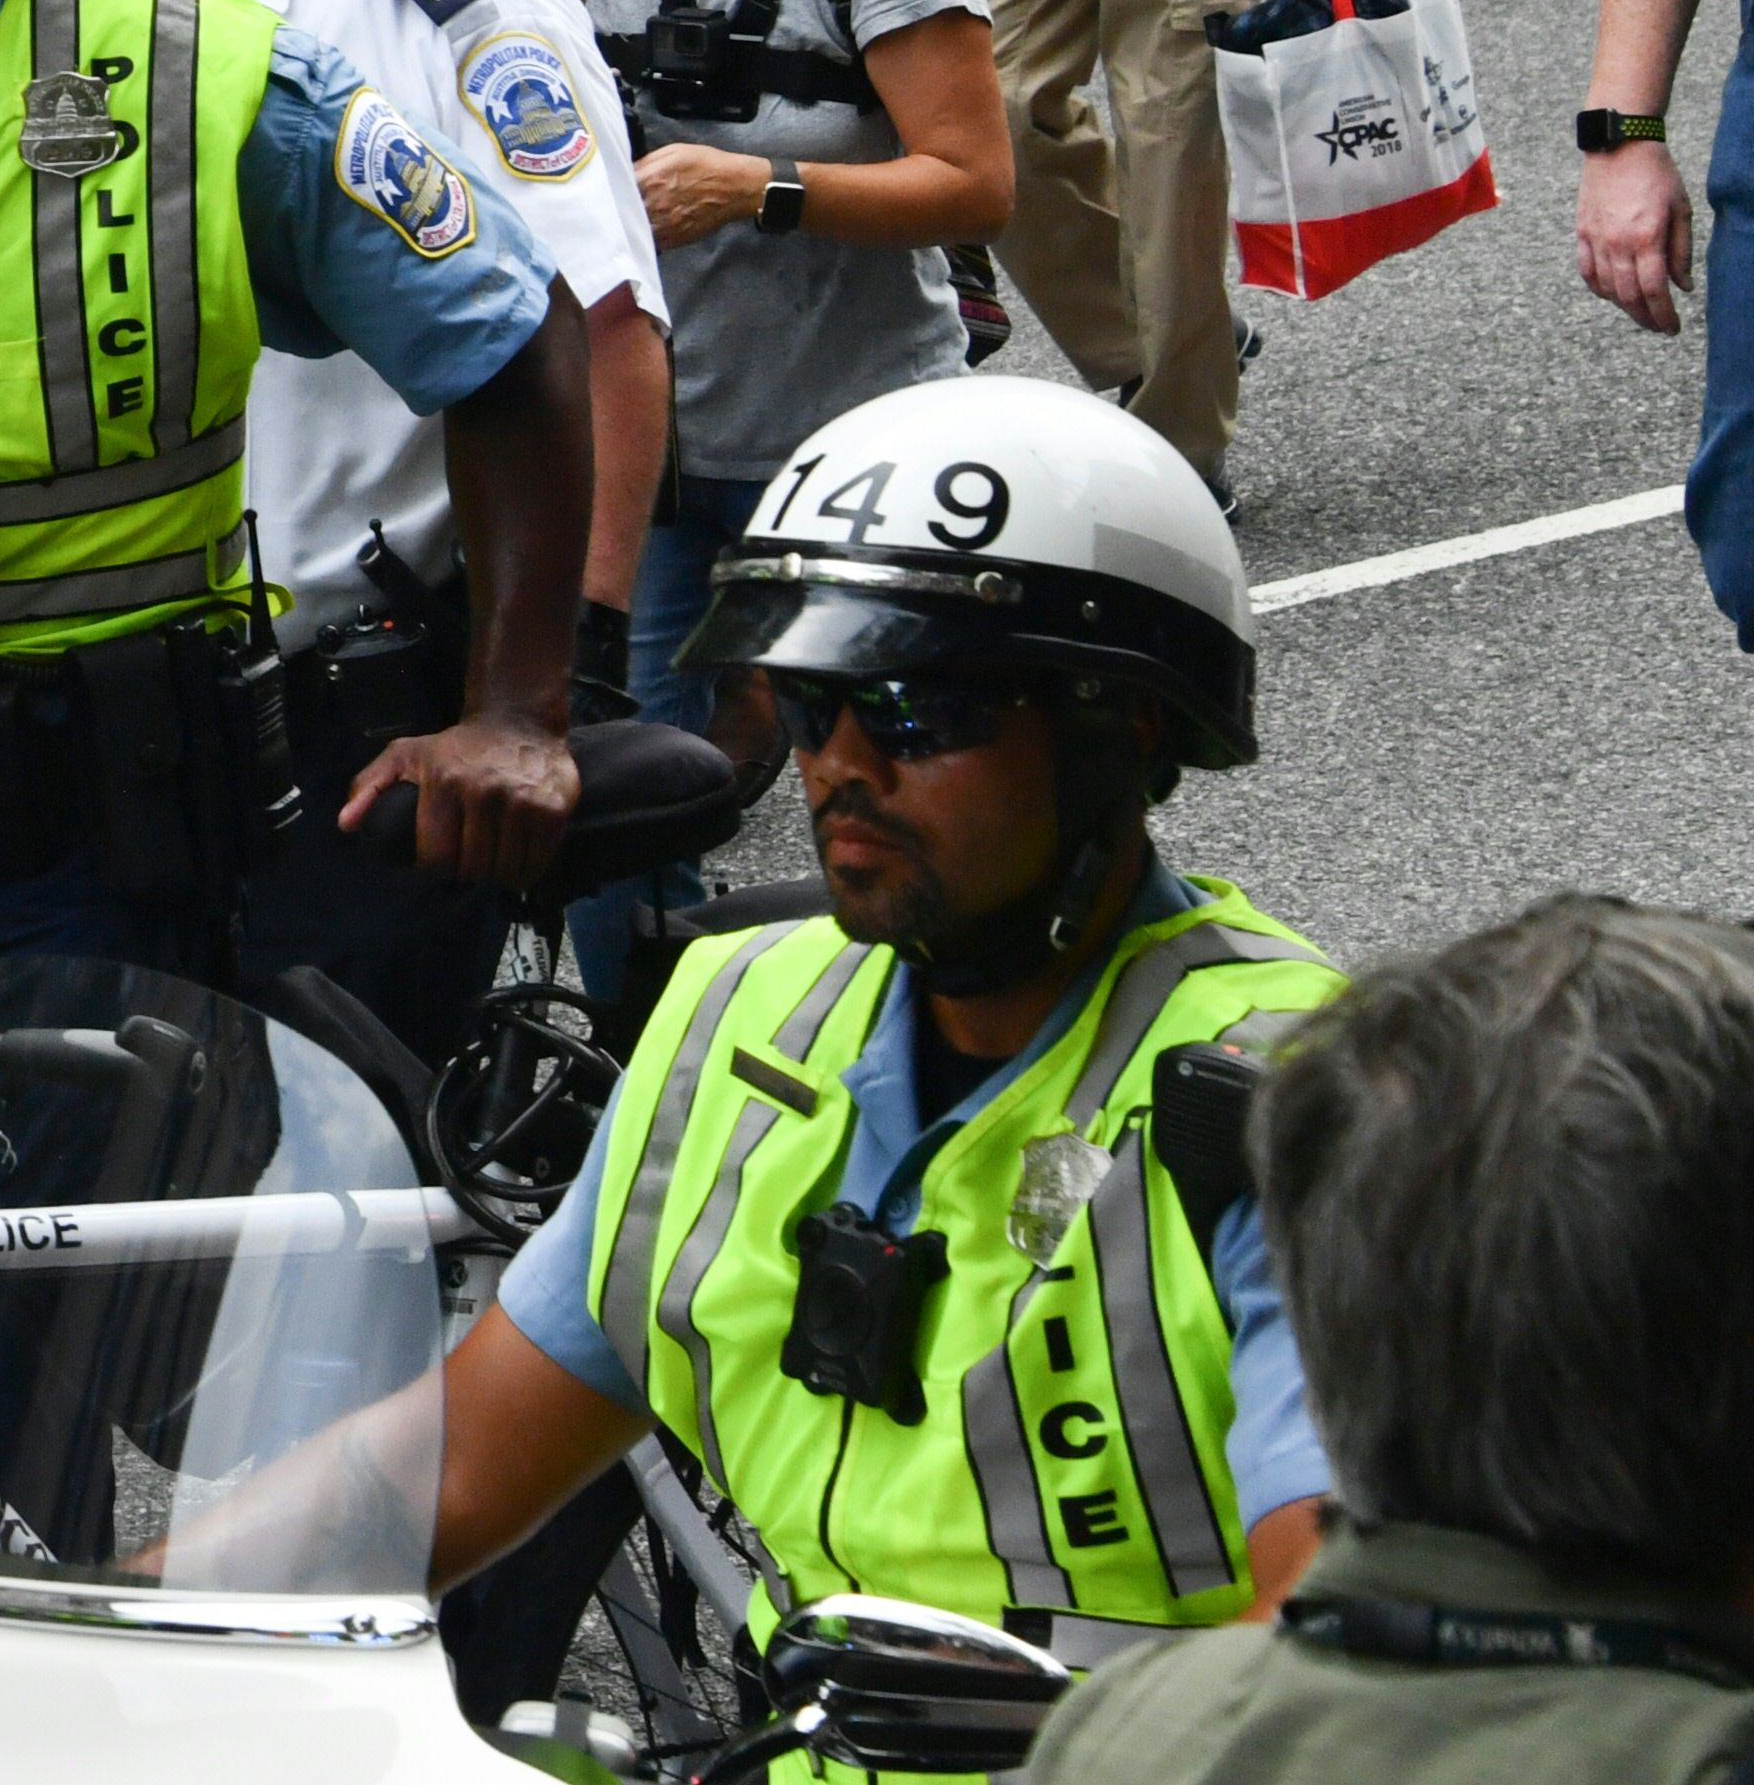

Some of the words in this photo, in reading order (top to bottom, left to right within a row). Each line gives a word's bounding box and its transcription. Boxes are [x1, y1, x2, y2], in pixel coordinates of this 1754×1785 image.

[467, 45, 529, 96] METROPOLITAN
[528, 46, 562, 71] POLICE
[1338, 117, 1399, 150] CPAC
[1370, 140, 1403, 158] 2018
[770, 453, 1011, 551] 149
[532, 934, 551, 985] TRUVA
[1039, 1264, 1131, 1549] ICE
